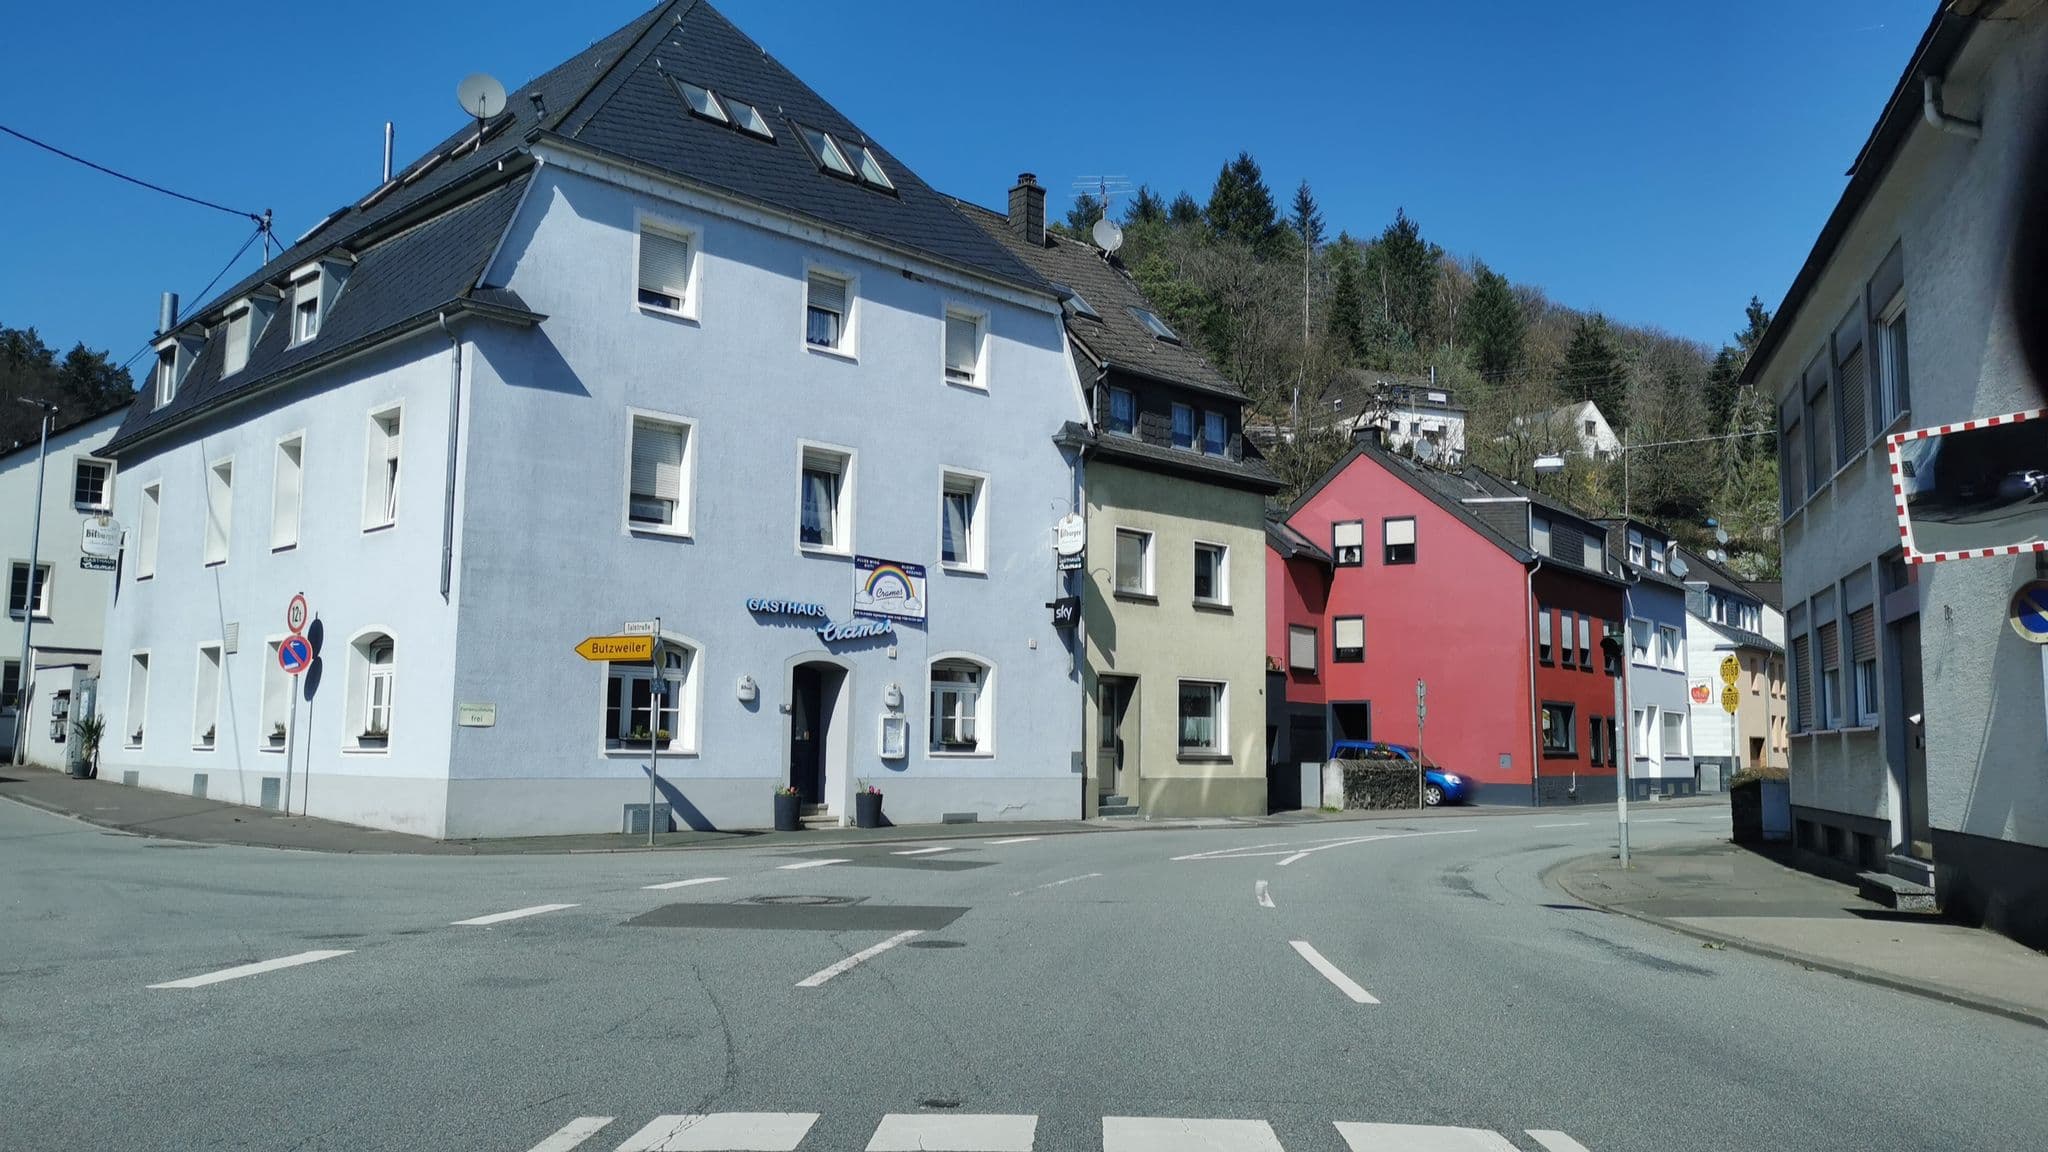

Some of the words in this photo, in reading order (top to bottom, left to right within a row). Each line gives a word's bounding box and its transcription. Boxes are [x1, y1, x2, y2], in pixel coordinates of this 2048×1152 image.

[747, 599, 826, 617] GASTHAUS
[1055, 605, 1073, 621] sky
[591, 642, 647, 654] Butzweiler
